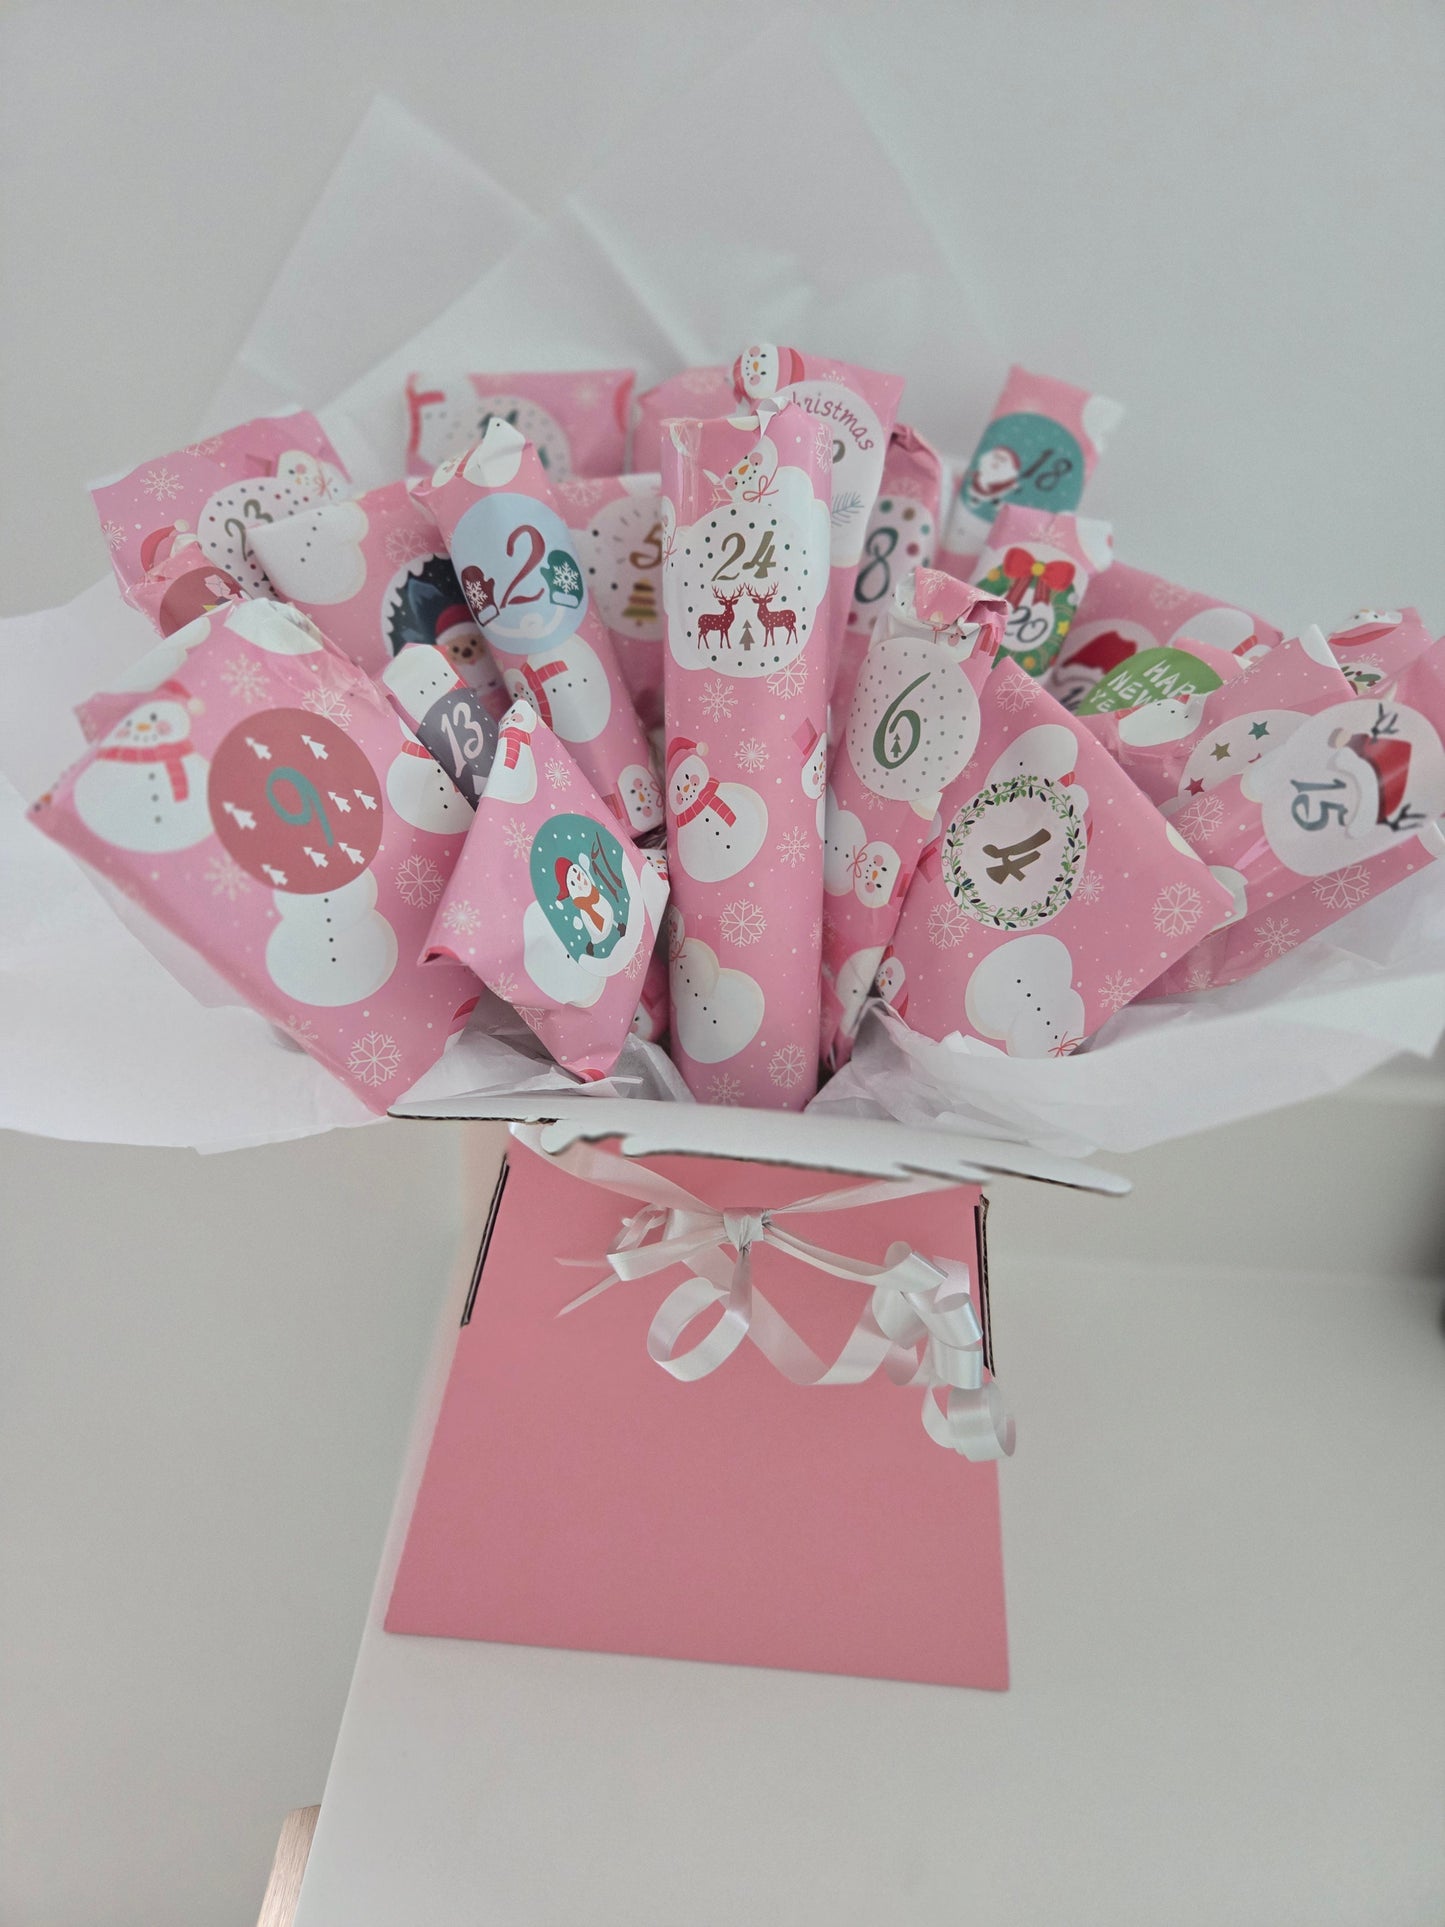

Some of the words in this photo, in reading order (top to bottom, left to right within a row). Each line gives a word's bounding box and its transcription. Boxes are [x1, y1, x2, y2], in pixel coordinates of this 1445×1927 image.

[1018, 448, 1073, 493] 18
[224, 499, 274, 562] 23
[629, 521, 663, 570] 5
[711, 530, 777, 581] 24
[499, 524, 546, 609] 2
[854, 526, 899, 604] 8
[1004, 606, 1048, 643] 20
[1090, 688, 1116, 712] YE
[1143, 659, 1197, 699] HAP
[441, 701, 484, 778] 13
[872, 671, 931, 770] 6
[266, 766, 334, 848] 9
[1289, 778, 1349, 832] 15
[982, 827, 1052, 885] 4
